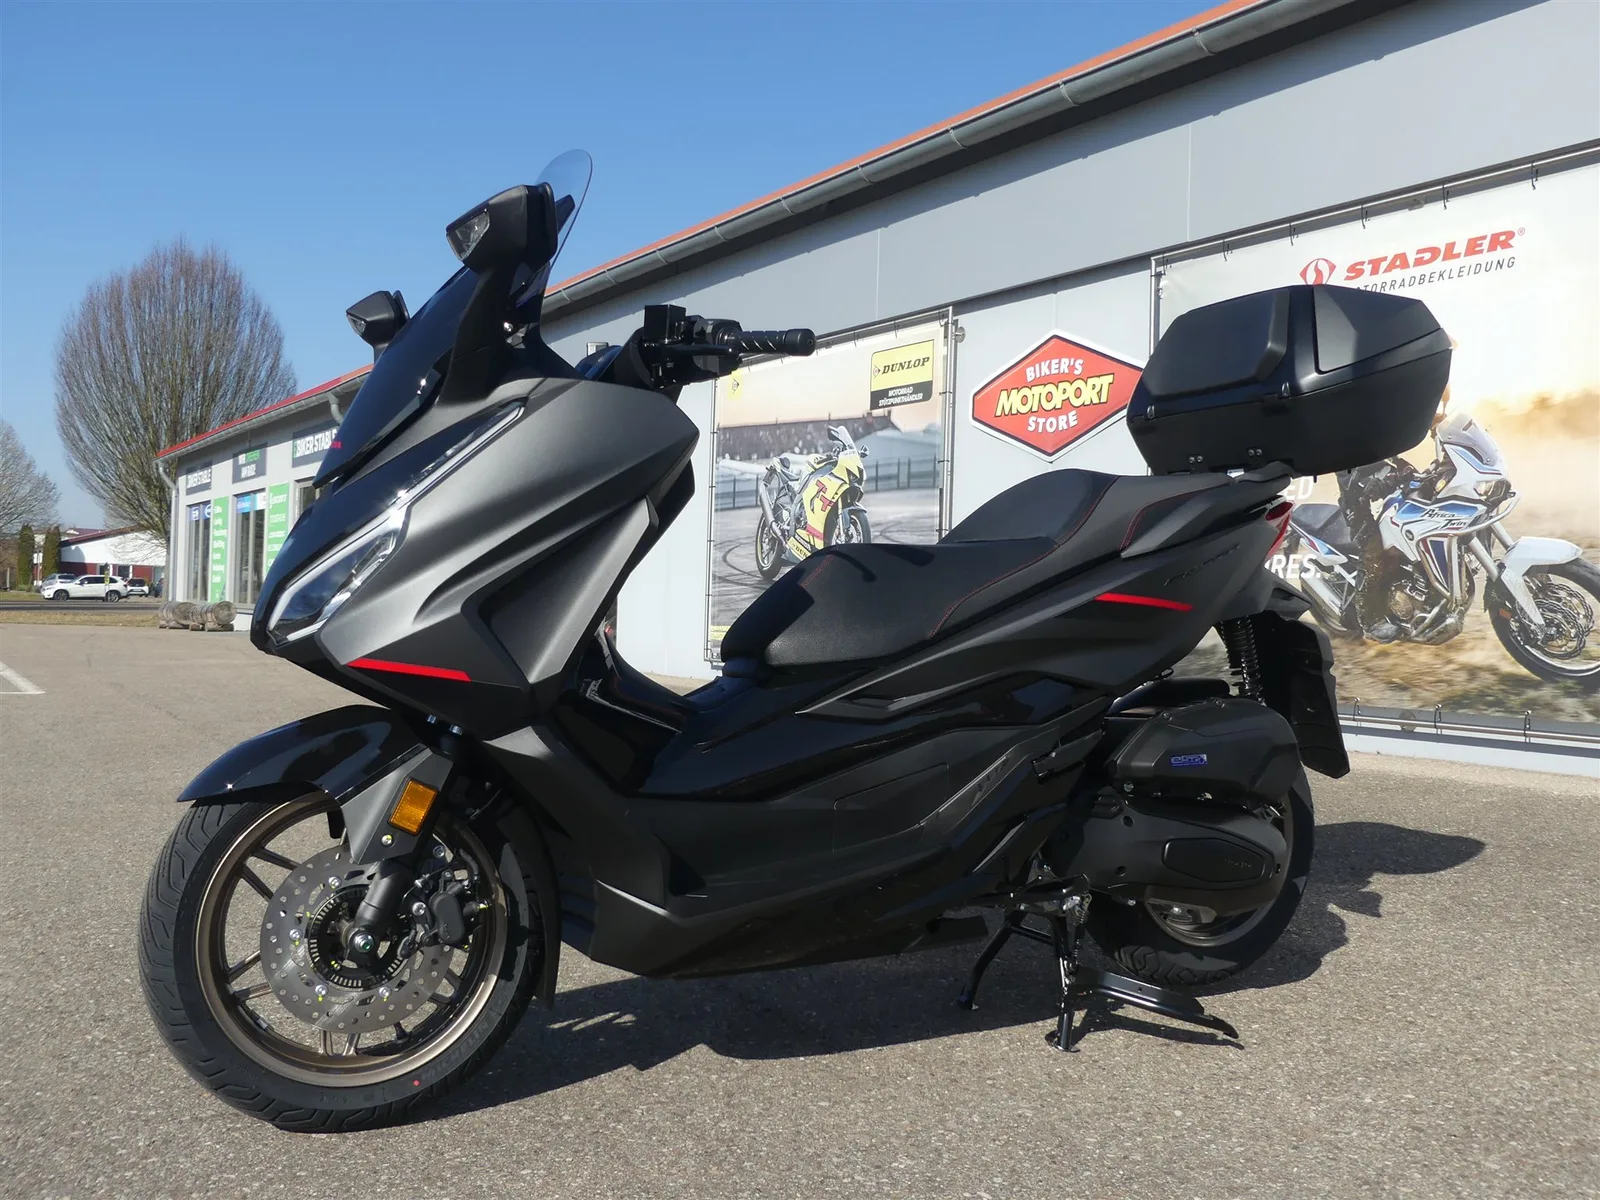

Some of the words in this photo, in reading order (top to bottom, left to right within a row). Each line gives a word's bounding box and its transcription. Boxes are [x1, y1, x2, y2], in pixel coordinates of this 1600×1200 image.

[1343, 230, 1516, 281] STADLER
[1357, 256, 1516, 293] TORRADBEKLEIDUNG
[881, 356, 930, 375] DUNLOP
[1025, 357, 1084, 383] BIKER'S
[888, 386, 914, 397] MOTORRAD
[994, 373, 1115, 418] MOTOPORT
[1027, 410, 1078, 433] STORE
[1420, 508, 1456, 519] Africa
[1441, 518, 1467, 529] Twin
